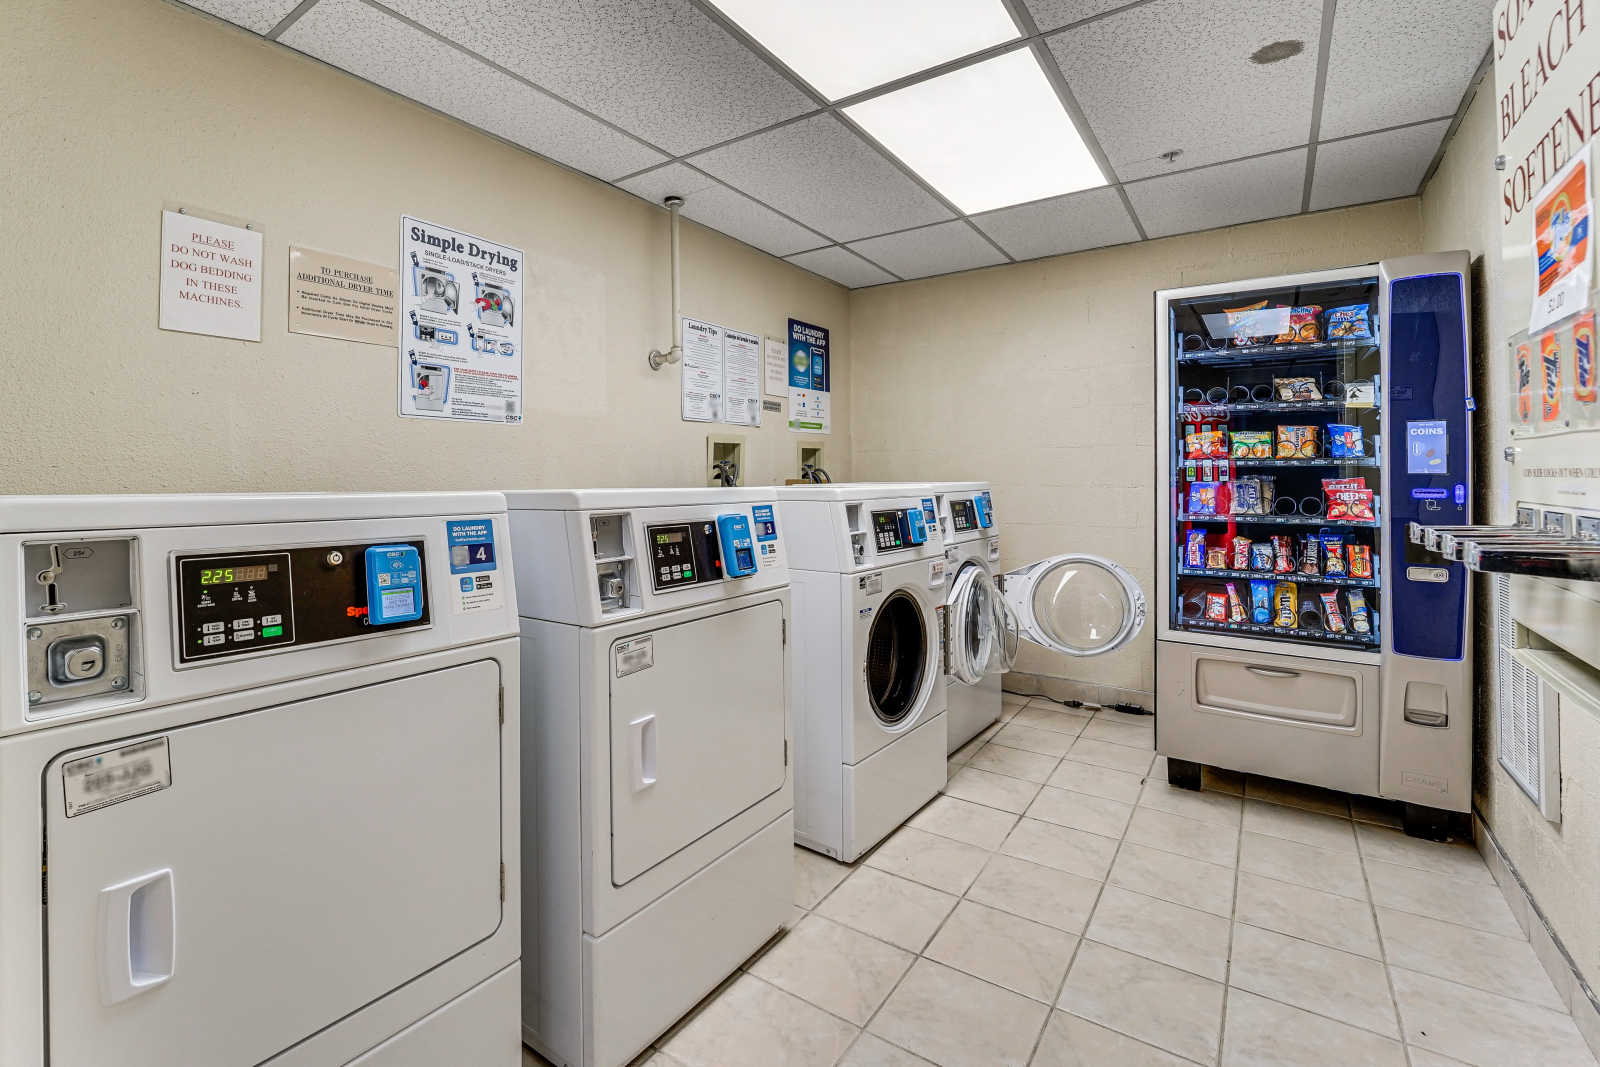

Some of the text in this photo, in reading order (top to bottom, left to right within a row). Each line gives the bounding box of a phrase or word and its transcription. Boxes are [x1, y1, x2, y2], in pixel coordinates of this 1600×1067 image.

[1500, 0, 1587, 143] BLEACH
[191, 233, 235, 250] PLEASE
[411, 226, 464, 254] Simple
[468, 242, 518, 272] Drying
[171, 244, 253, 268] DO NOT WASH
[424, 250, 484, 271] SINGLE-LOAD/STACK
[485, 265, 507, 277] DRYERS
[170, 259, 252, 283] DOG BEDDING
[320, 266, 374, 284] TO PURCHASE
[185, 277, 238, 295] IN THESE
[296, 272, 394, 298] ADDITIONAL DRYER TIME
[179, 290, 243, 309] MACHINES.
[1334, 310, 1355, 318] Chex
[688, 322, 718, 336] Laundry Tips
[793, 323, 825, 340] DO LAUNDRY
[792, 331, 826, 347] WITH THE APP
[1575, 333, 1591, 389] Tide
[1542, 354, 1558, 400] Tide
[1410, 427, 1444, 436] COINS
[1558, 468, 1568, 478] OUT
[1568, 468, 1584, 478] WHEN
[766, 523, 773, 534] 3
[475, 546, 487, 561] 4
[1189, 542, 1200, 566] CRUNCH
[1237, 543, 1249, 565] TWIX
[201, 569, 233, 584] 2.25
